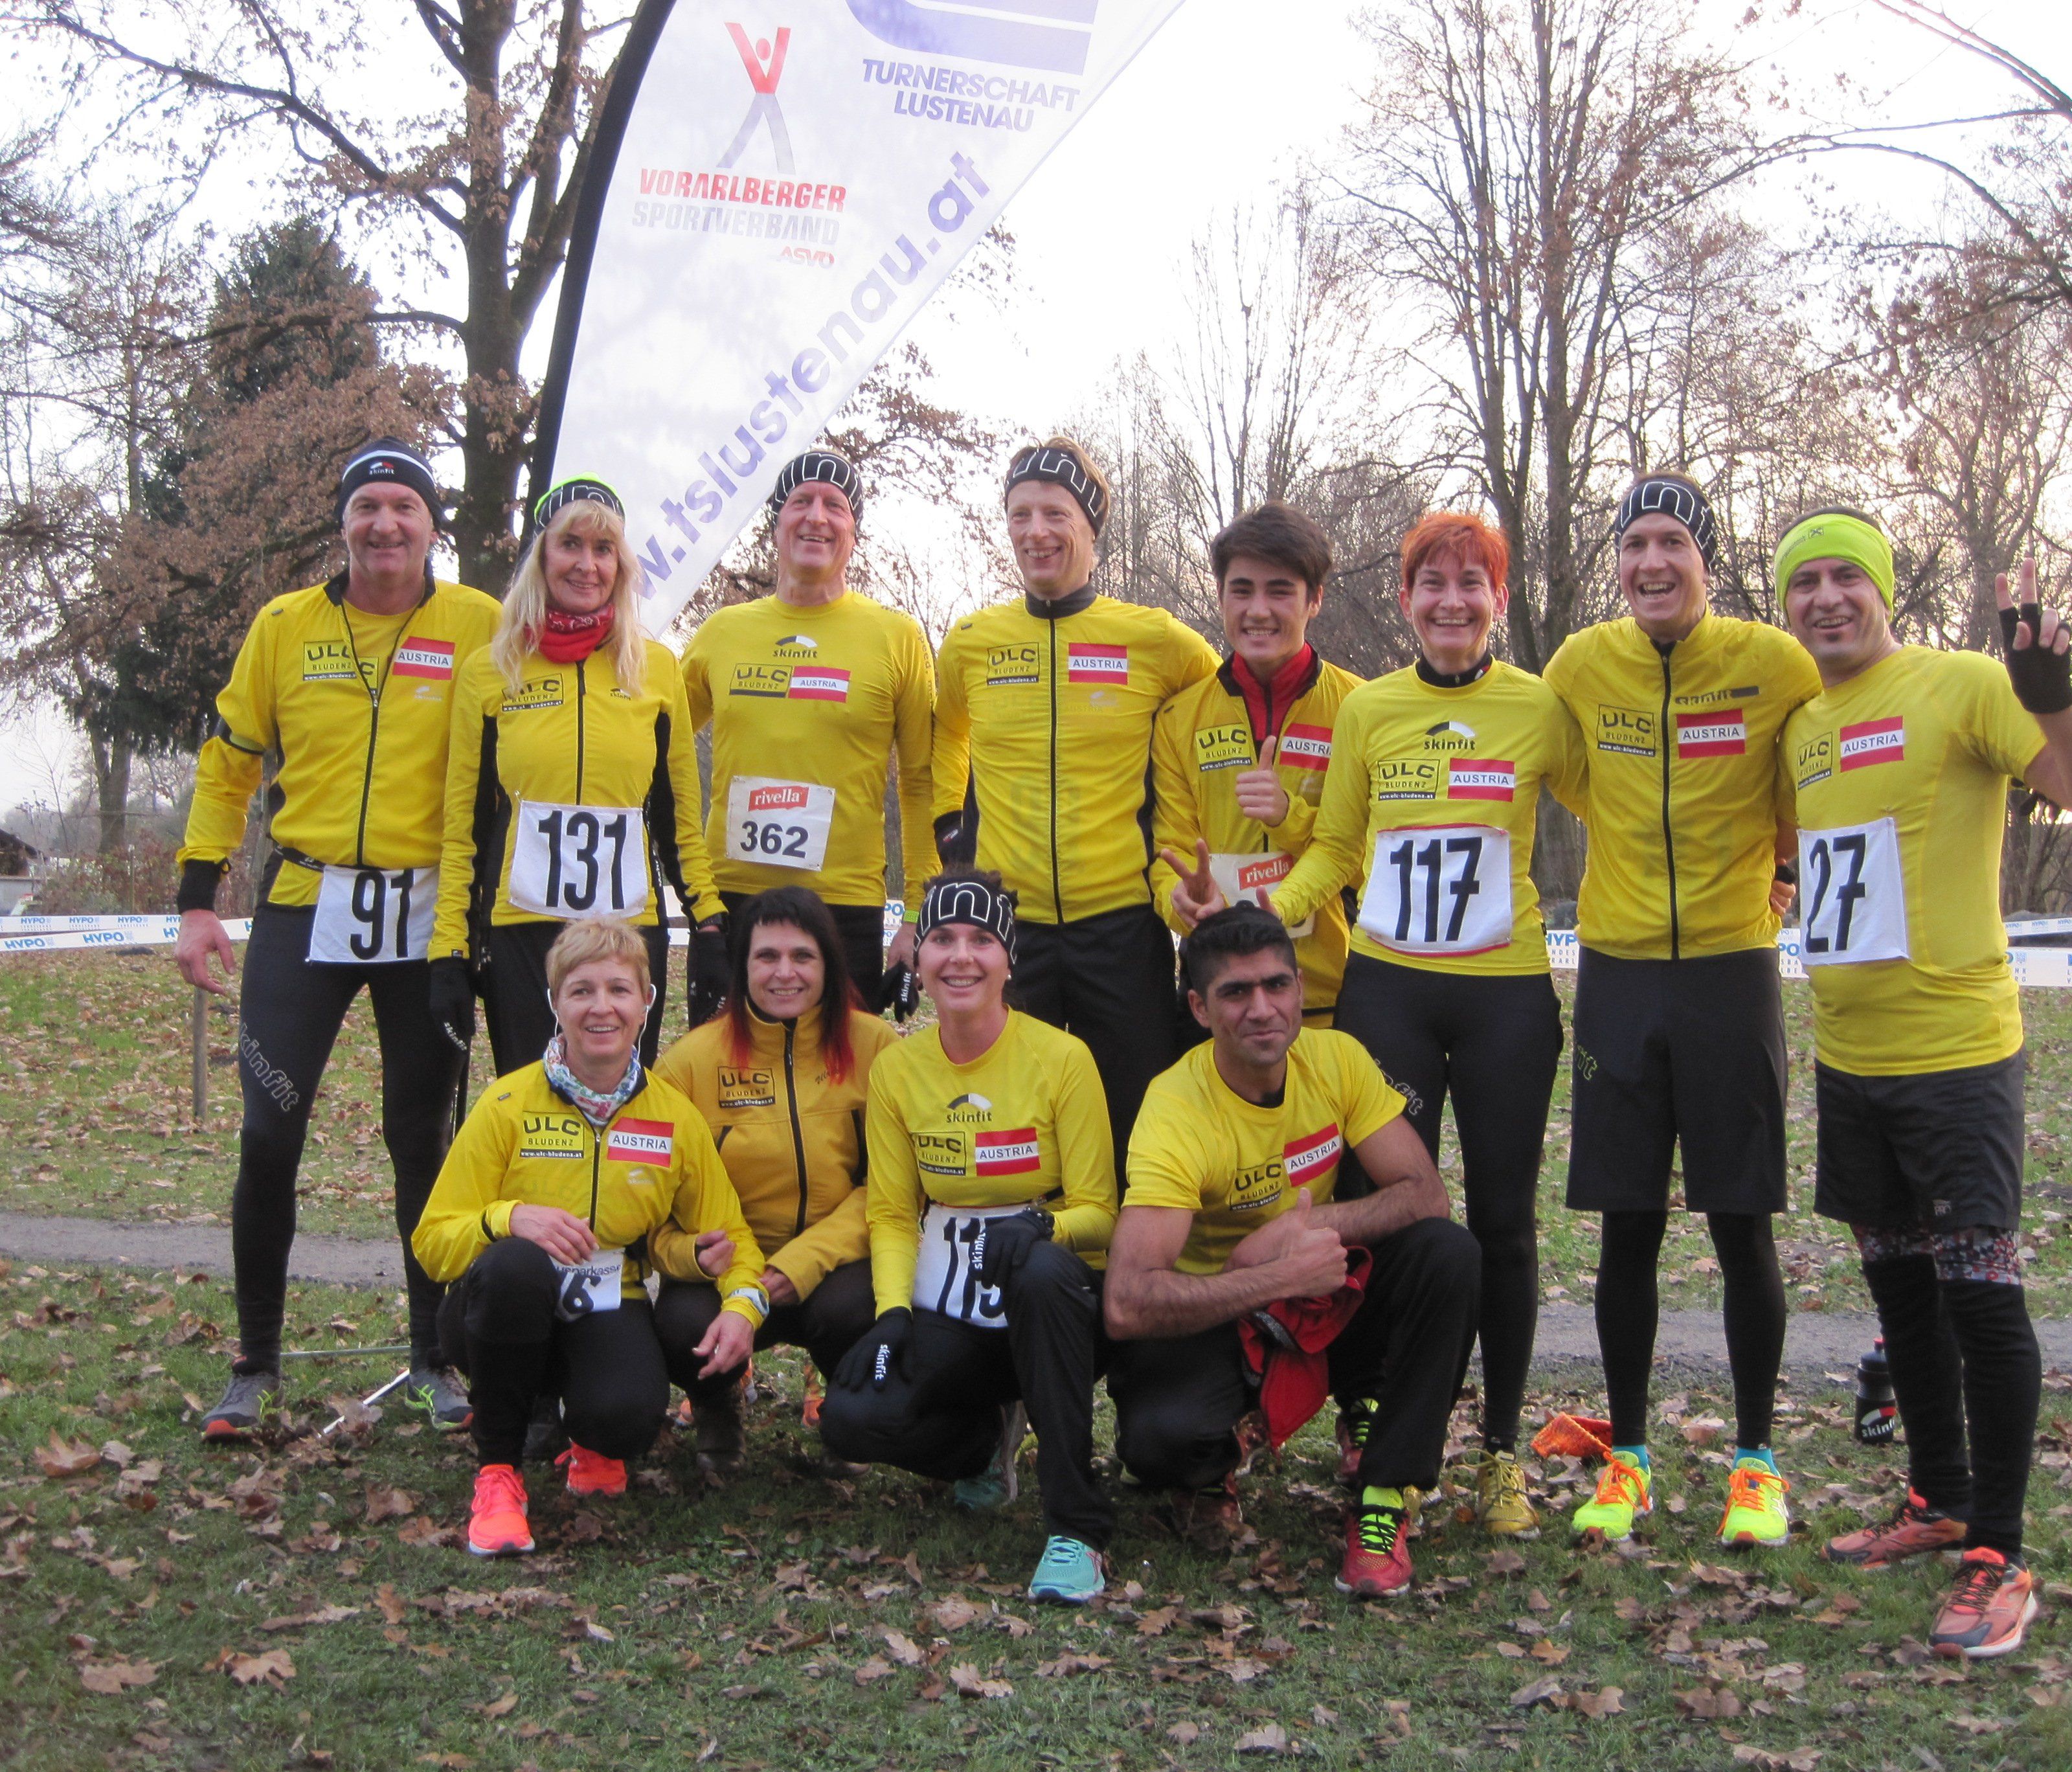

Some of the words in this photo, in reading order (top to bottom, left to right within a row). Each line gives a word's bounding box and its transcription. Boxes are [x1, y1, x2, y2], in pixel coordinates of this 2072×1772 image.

[862, 58, 1081, 112] TURNERSCHAFT
[894, 91, 1034, 132] LUSTENAU
[640, 168, 846, 212] VORARLBERGER
[632, 201, 840, 245] SPORTVERBAND
[633, 151, 989, 600] w.tslustenau.at
[398, 652, 449, 665] AUSTRIA
[772, 648, 817, 658] skinfit
[991, 648, 1036, 666] ULC
[995, 666, 1030, 674] BLUDENZ
[1073, 659, 1123, 669] AUSTRIA
[737, 667, 788, 683] ULC
[739, 681, 778, 690] BLUDENZ
[1603, 712, 1652, 734] ULC
[1199, 729, 1247, 749] ULC
[1606, 732, 1645, 744] BLUDENZ
[1683, 727, 1740, 740] AUSTRIA
[1206, 747, 1243, 758] BLUDENZ
[1286, 740, 1332, 756] AUSTRI
[1424, 739, 1476, 750] skinfit
[1843, 734, 1898, 754] AUSTRIA
[1799, 741, 1829, 766] ULC
[1382, 762, 1435, 780] ULC
[1454, 775, 1509, 784] AUSTRIA
[755, 789, 800, 806] rivella
[740, 821, 809, 858] 362
[539, 810, 626, 911] 131
[1246, 859, 1289, 883] rivella
[1390, 836, 1482, 942] 117
[1805, 833, 1866, 953] 27
[350, 869, 414, 960] 91
[5, 938, 45, 949] HYPO
[83, 931, 124, 943] HYPO
[241, 1022, 299, 1111] kinfit
[721, 1072, 771, 1087] ULC
[726, 1088, 767, 1097] BLUDENZ
[946, 1111, 993, 1123] skinfit
[524, 1117, 581, 1136] ULC
[528, 1137, 573, 1146] BLUDENZ
[613, 1134, 668, 1150] AUSTRIA
[918, 1135, 962, 1153] ULC
[921, 1152, 957, 1163] BLUDENZ
[980, 1145, 1034, 1159] AUSTRIA
[1290, 1140, 1337, 1169] AUSTRIA
[1235, 1164, 1281, 1191] ULC
[972, 1232, 986, 1269] skinfit
[875, 1344, 891, 1380] skinfit
